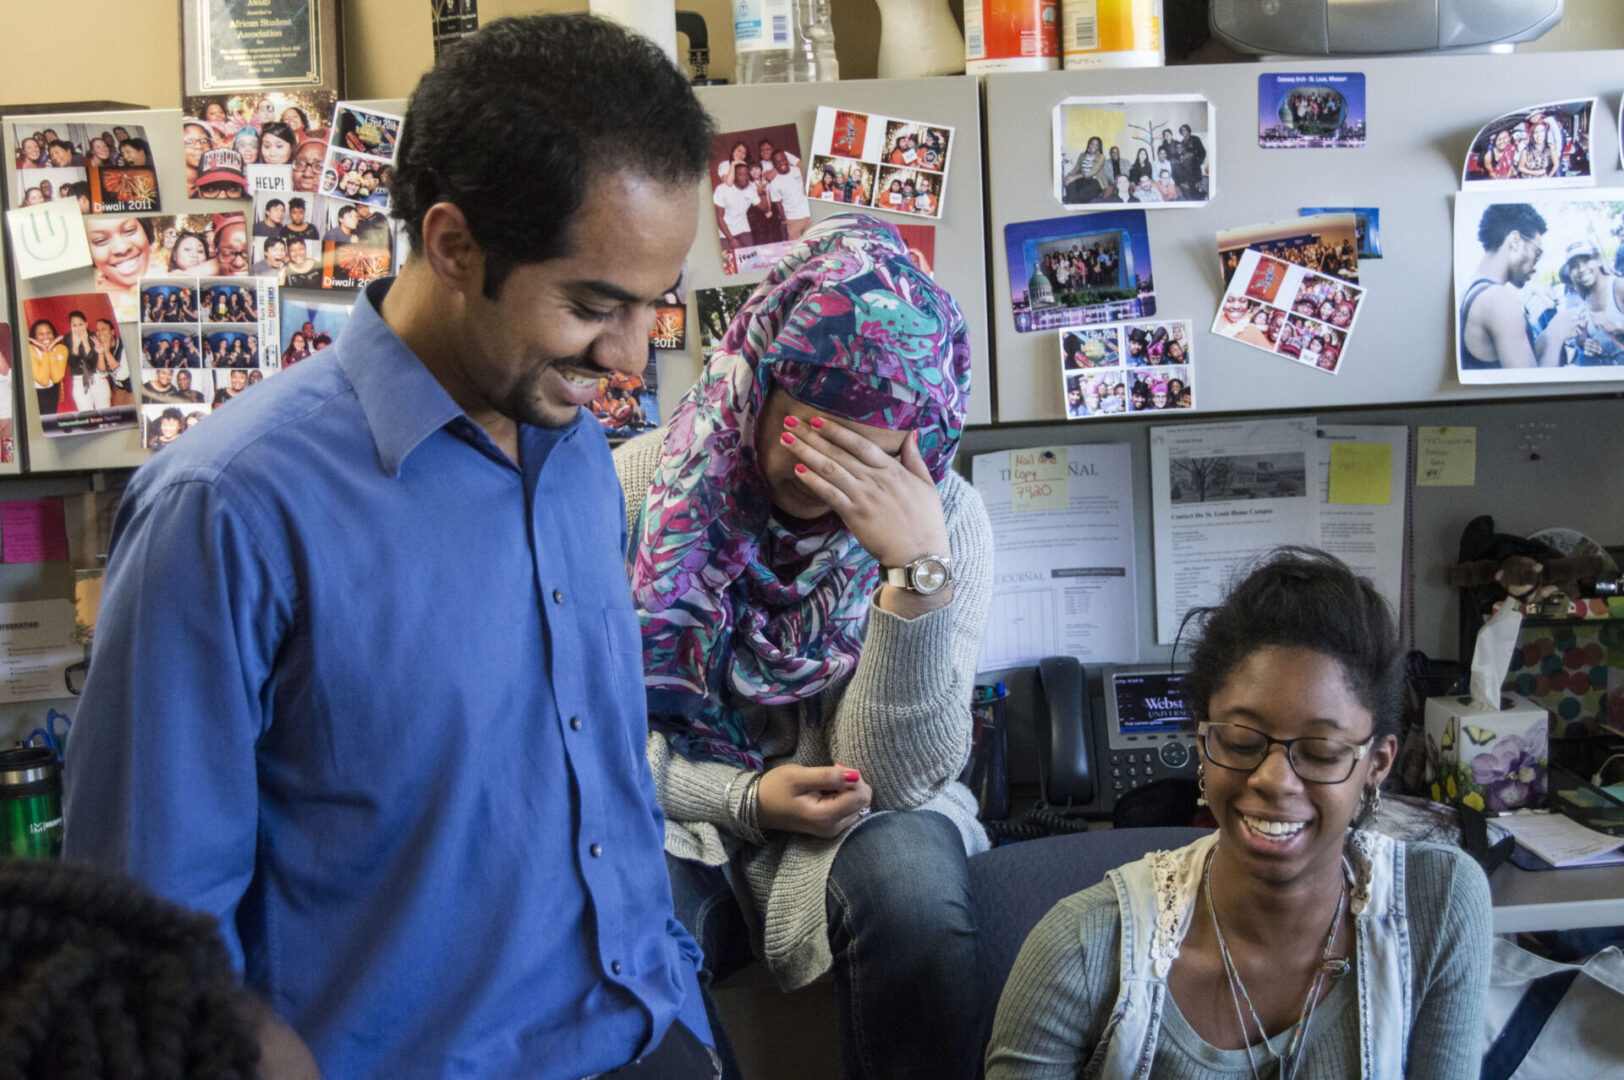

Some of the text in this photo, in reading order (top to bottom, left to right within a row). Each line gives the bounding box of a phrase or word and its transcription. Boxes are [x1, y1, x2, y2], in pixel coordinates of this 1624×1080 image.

[230, 18, 292, 28] African Student
[238, 30, 282, 39] Association
[256, 176, 285, 190] HELP!
[94, 199, 152, 212] Diwali 2011
[324, 276, 354, 286] Diwali
[654, 338, 676, 348] 2011
[1145, 697, 1184, 710] Webst
